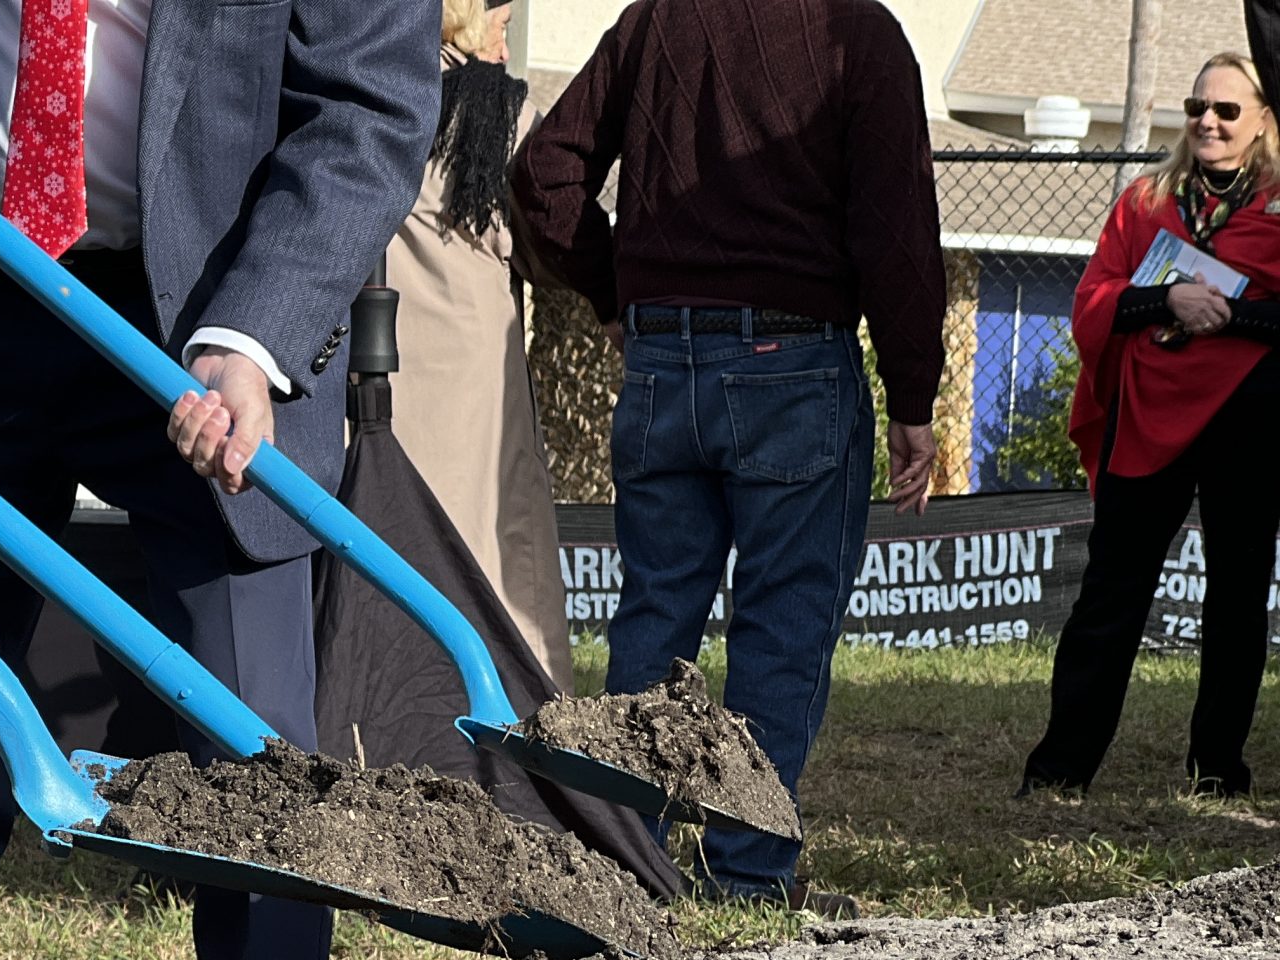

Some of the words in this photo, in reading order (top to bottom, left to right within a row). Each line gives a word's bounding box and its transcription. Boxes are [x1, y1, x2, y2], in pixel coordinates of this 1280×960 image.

[854, 539, 943, 586] ARK
[955, 527, 1061, 579] HUNT
[845, 575, 1042, 618] ONSTRUCTION
